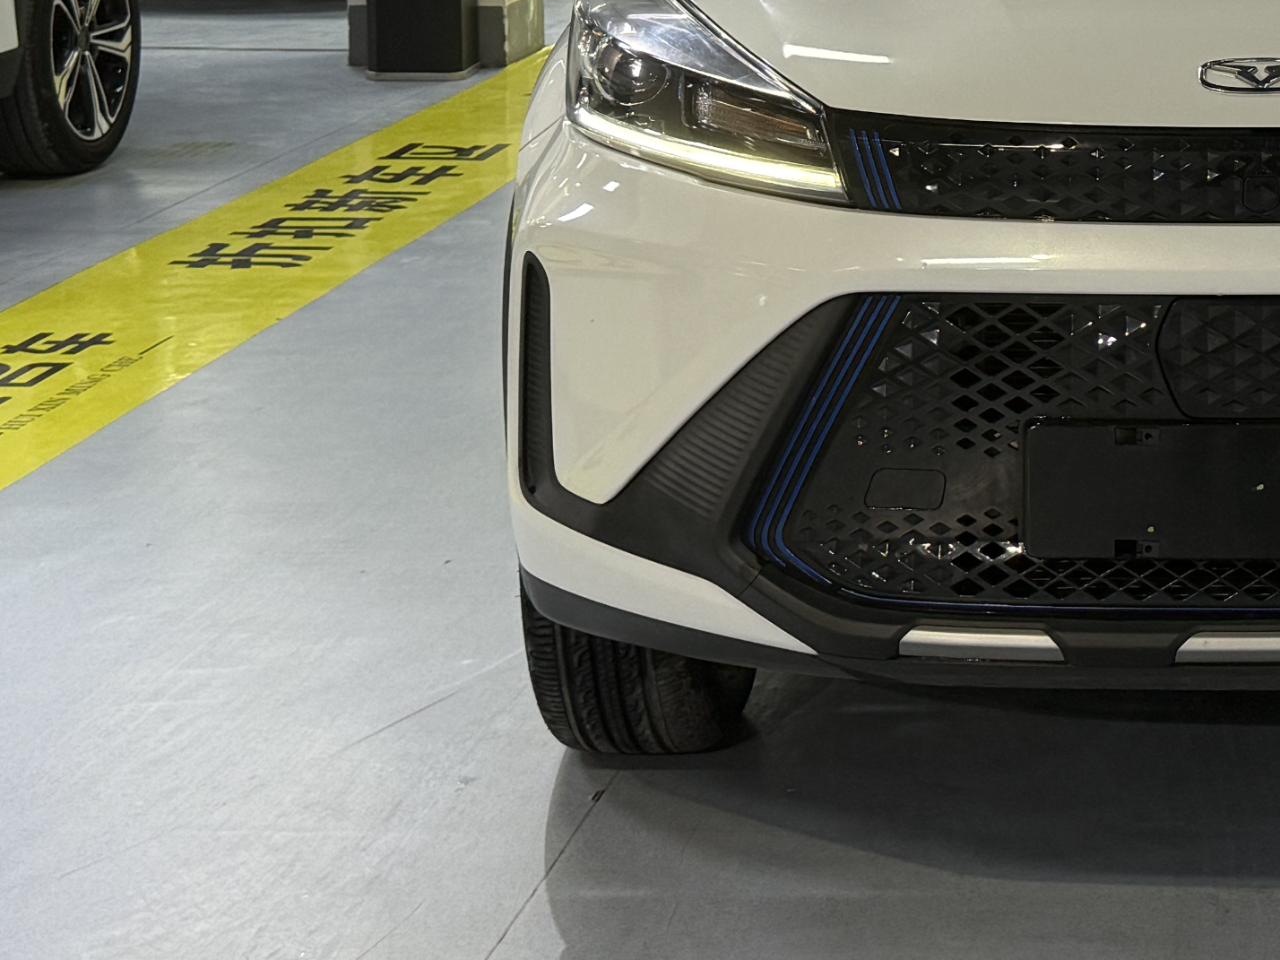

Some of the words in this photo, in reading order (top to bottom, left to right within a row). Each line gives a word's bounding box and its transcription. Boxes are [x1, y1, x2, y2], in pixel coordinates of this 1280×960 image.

[169, 143, 511, 269] 折扣新车区
